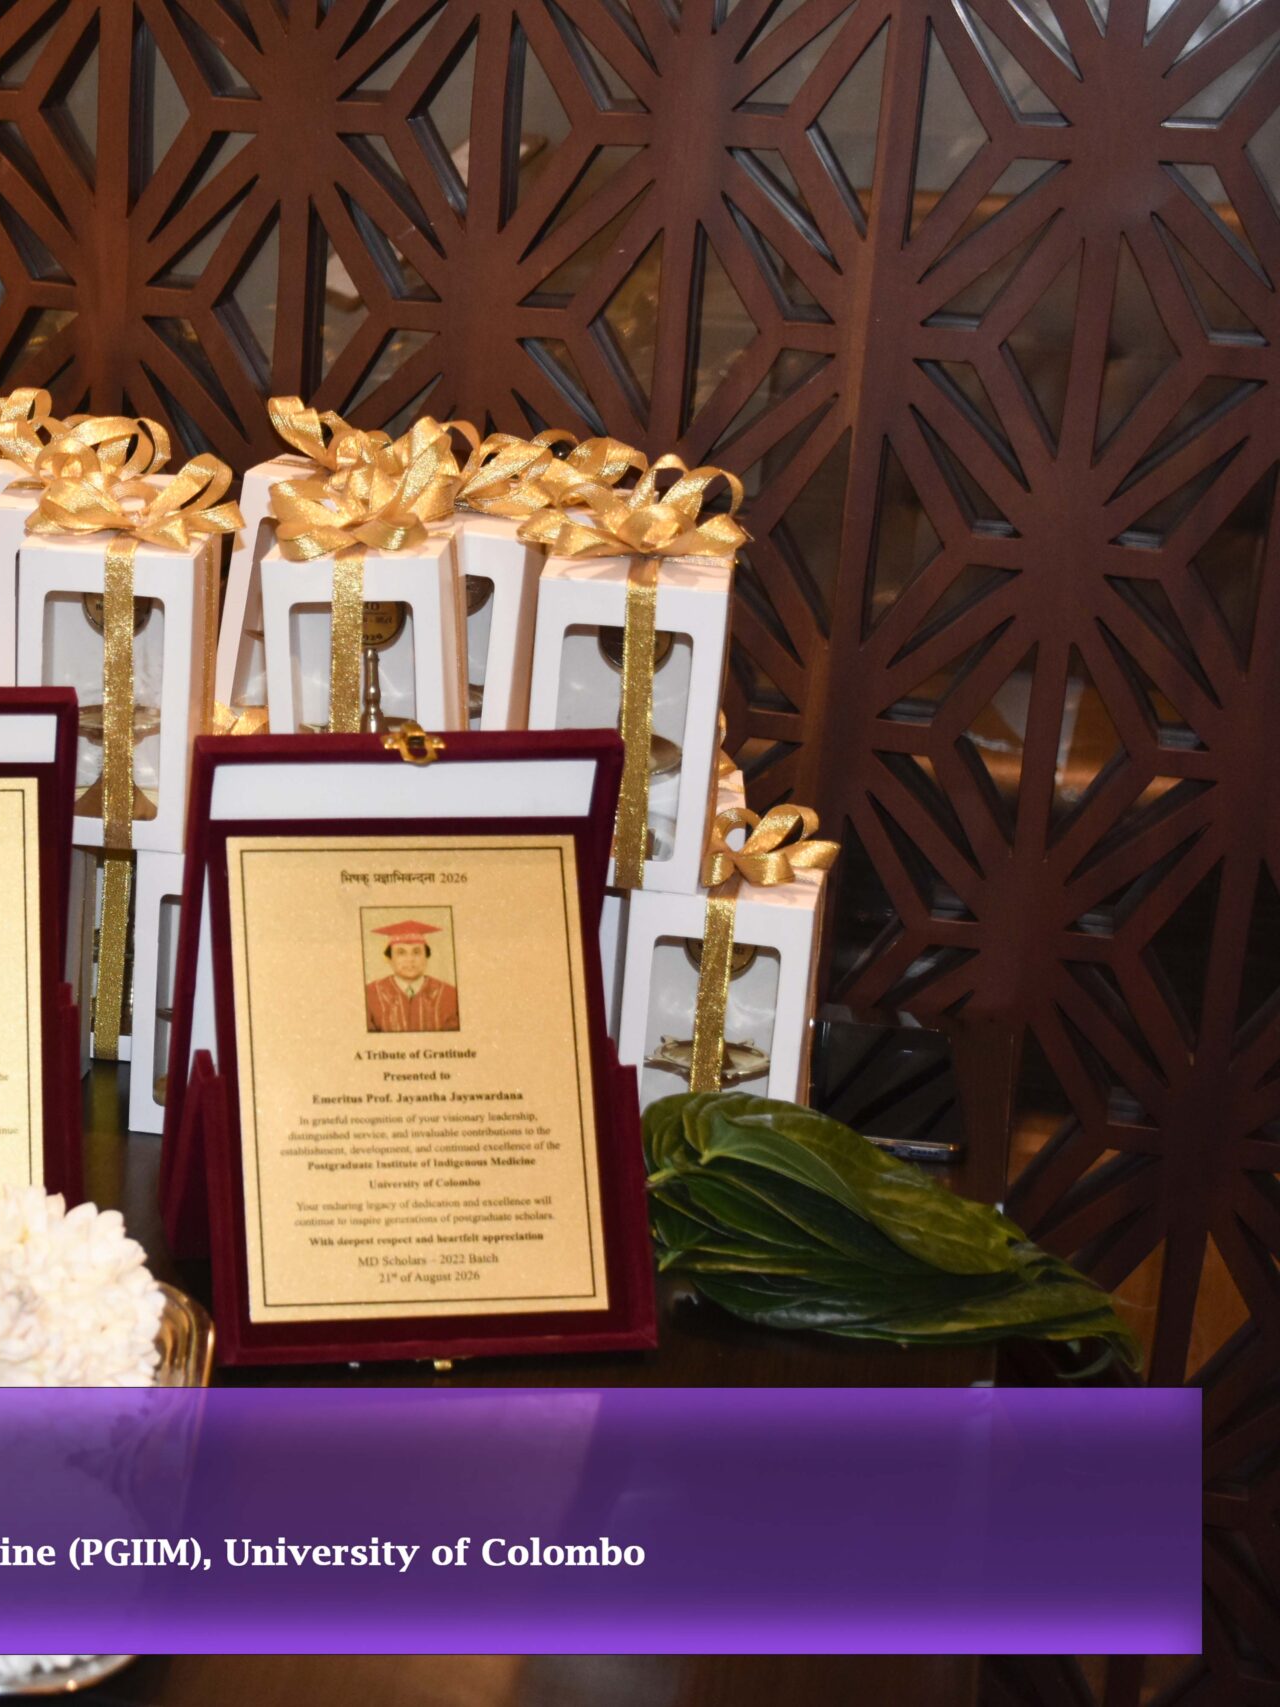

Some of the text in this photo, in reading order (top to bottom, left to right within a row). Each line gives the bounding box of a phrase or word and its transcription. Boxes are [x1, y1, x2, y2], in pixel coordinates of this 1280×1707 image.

[440, 873, 468, 884] 2026
[354, 1049, 477, 1060] A Tribute of Gratitude
[383, 1072, 451, 1081] Presented to
[312, 1092, 524, 1106] Emeritus Prof. Jayantha Jayawardana
[308, 1157, 536, 1172] Postgraduate Institute of Indigenous Medicine
[369, 1178, 481, 1192] University of Colombo
[309, 1232, 544, 1247] With deepest respect and heartfelt appreciation
[358, 1257, 380, 1267] MD
[382, 1255, 427, 1267] Scholars
[440, 1254, 466, 1265] 2022
[468, 1253, 499, 1264] Batch
[400, 1272, 412, 1283] of
[414, 1273, 452, 1285] August
[454, 1270, 480, 1282] 2026
